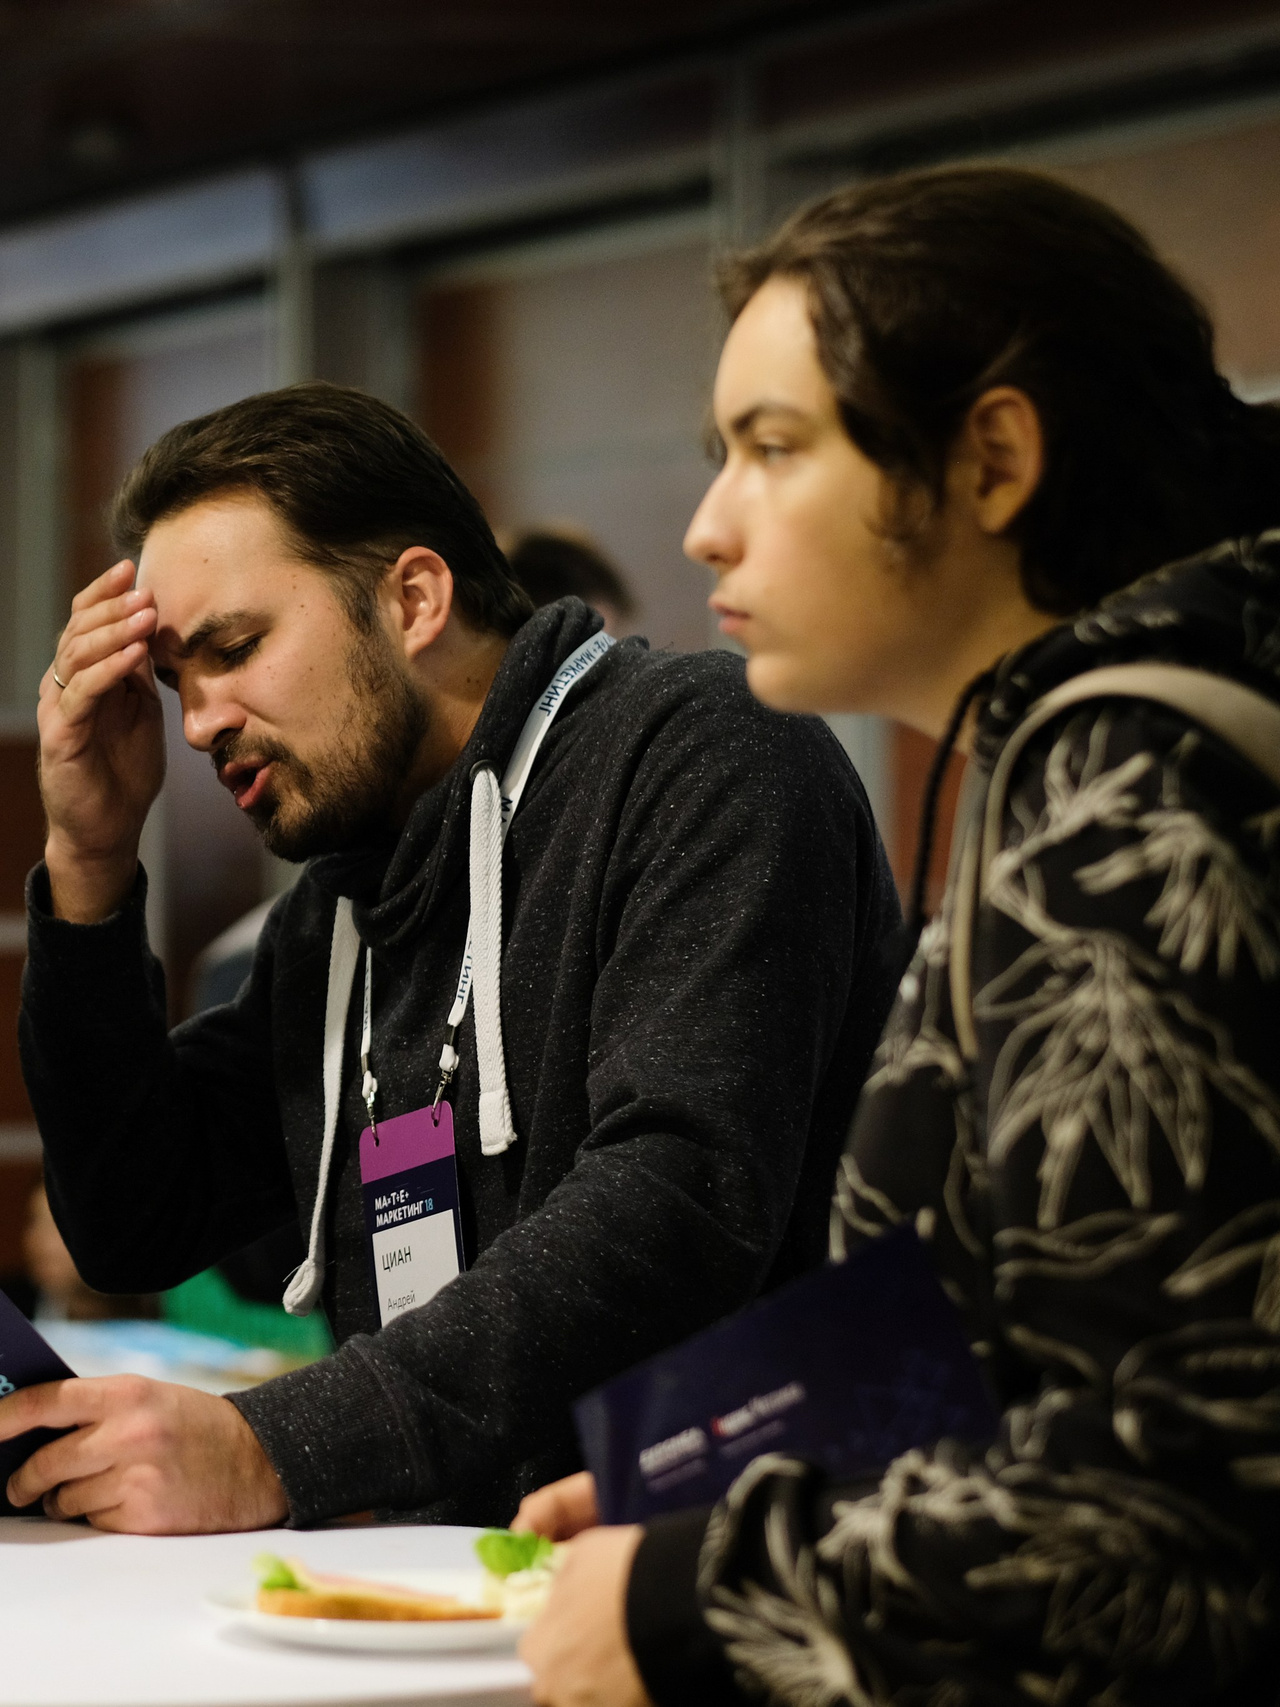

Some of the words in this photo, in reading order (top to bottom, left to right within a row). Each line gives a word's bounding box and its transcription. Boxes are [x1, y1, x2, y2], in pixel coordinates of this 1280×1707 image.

[538, 649, 596, 717] МАРКЕТИНГ
[376, 1200, 423, 1228] МАРКЕТИНГ
[424, 1198, 434, 1212] 18
[381, 1246, 412, 1272] ЦИАН
[387, 1289, 416, 1311] Андрей
